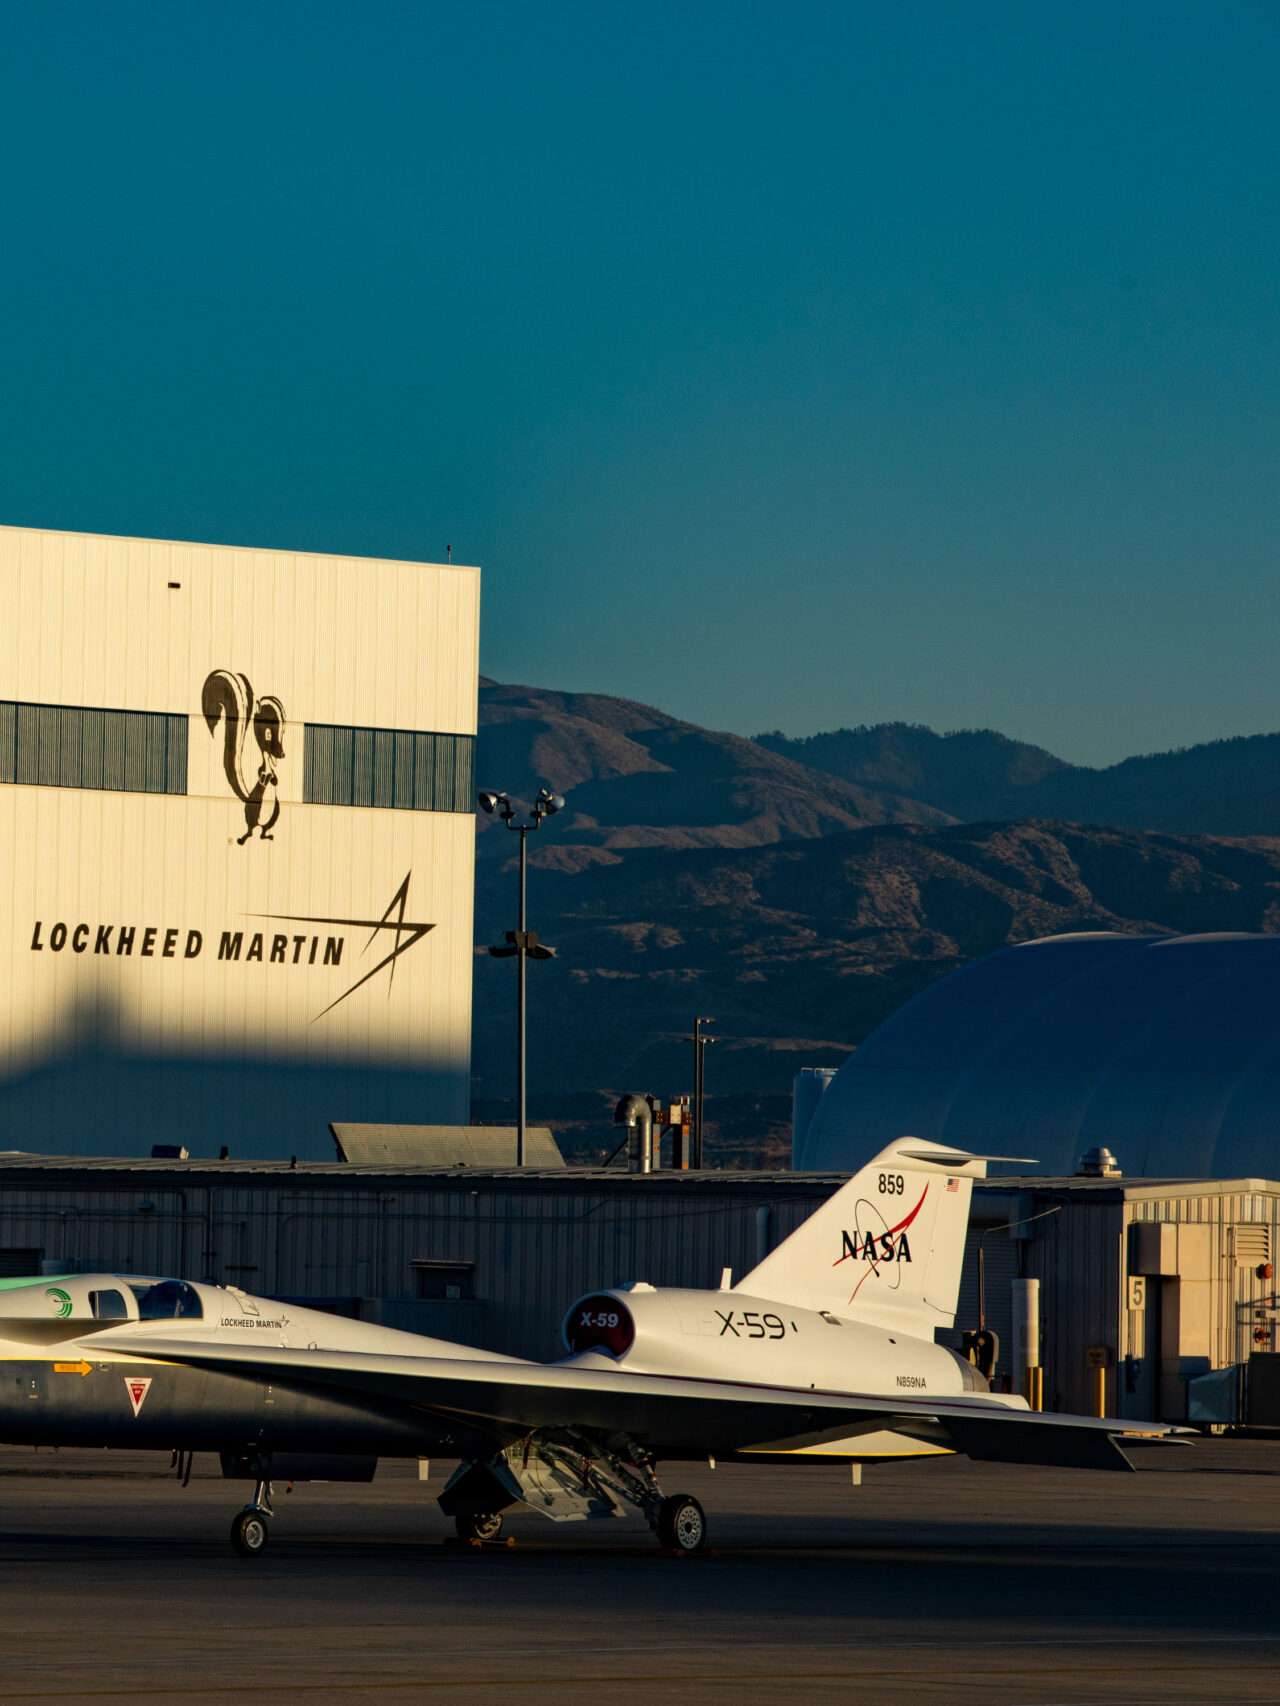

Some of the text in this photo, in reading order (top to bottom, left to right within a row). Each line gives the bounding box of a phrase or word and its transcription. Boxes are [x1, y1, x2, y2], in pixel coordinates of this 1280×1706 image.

[31, 921, 345, 966] LOCKHEED MARTIN
[878, 1173, 904, 1196] 859
[841, 1230, 912, 1263] NASA
[1133, 1280, 1143, 1306] 5
[221, 1318, 282, 1329] LOCKHEED MARTIN
[580, 1312, 619, 1328] X-59
[714, 1310, 786, 1339] X-59
[896, 1375, 927, 1390] N859NA
